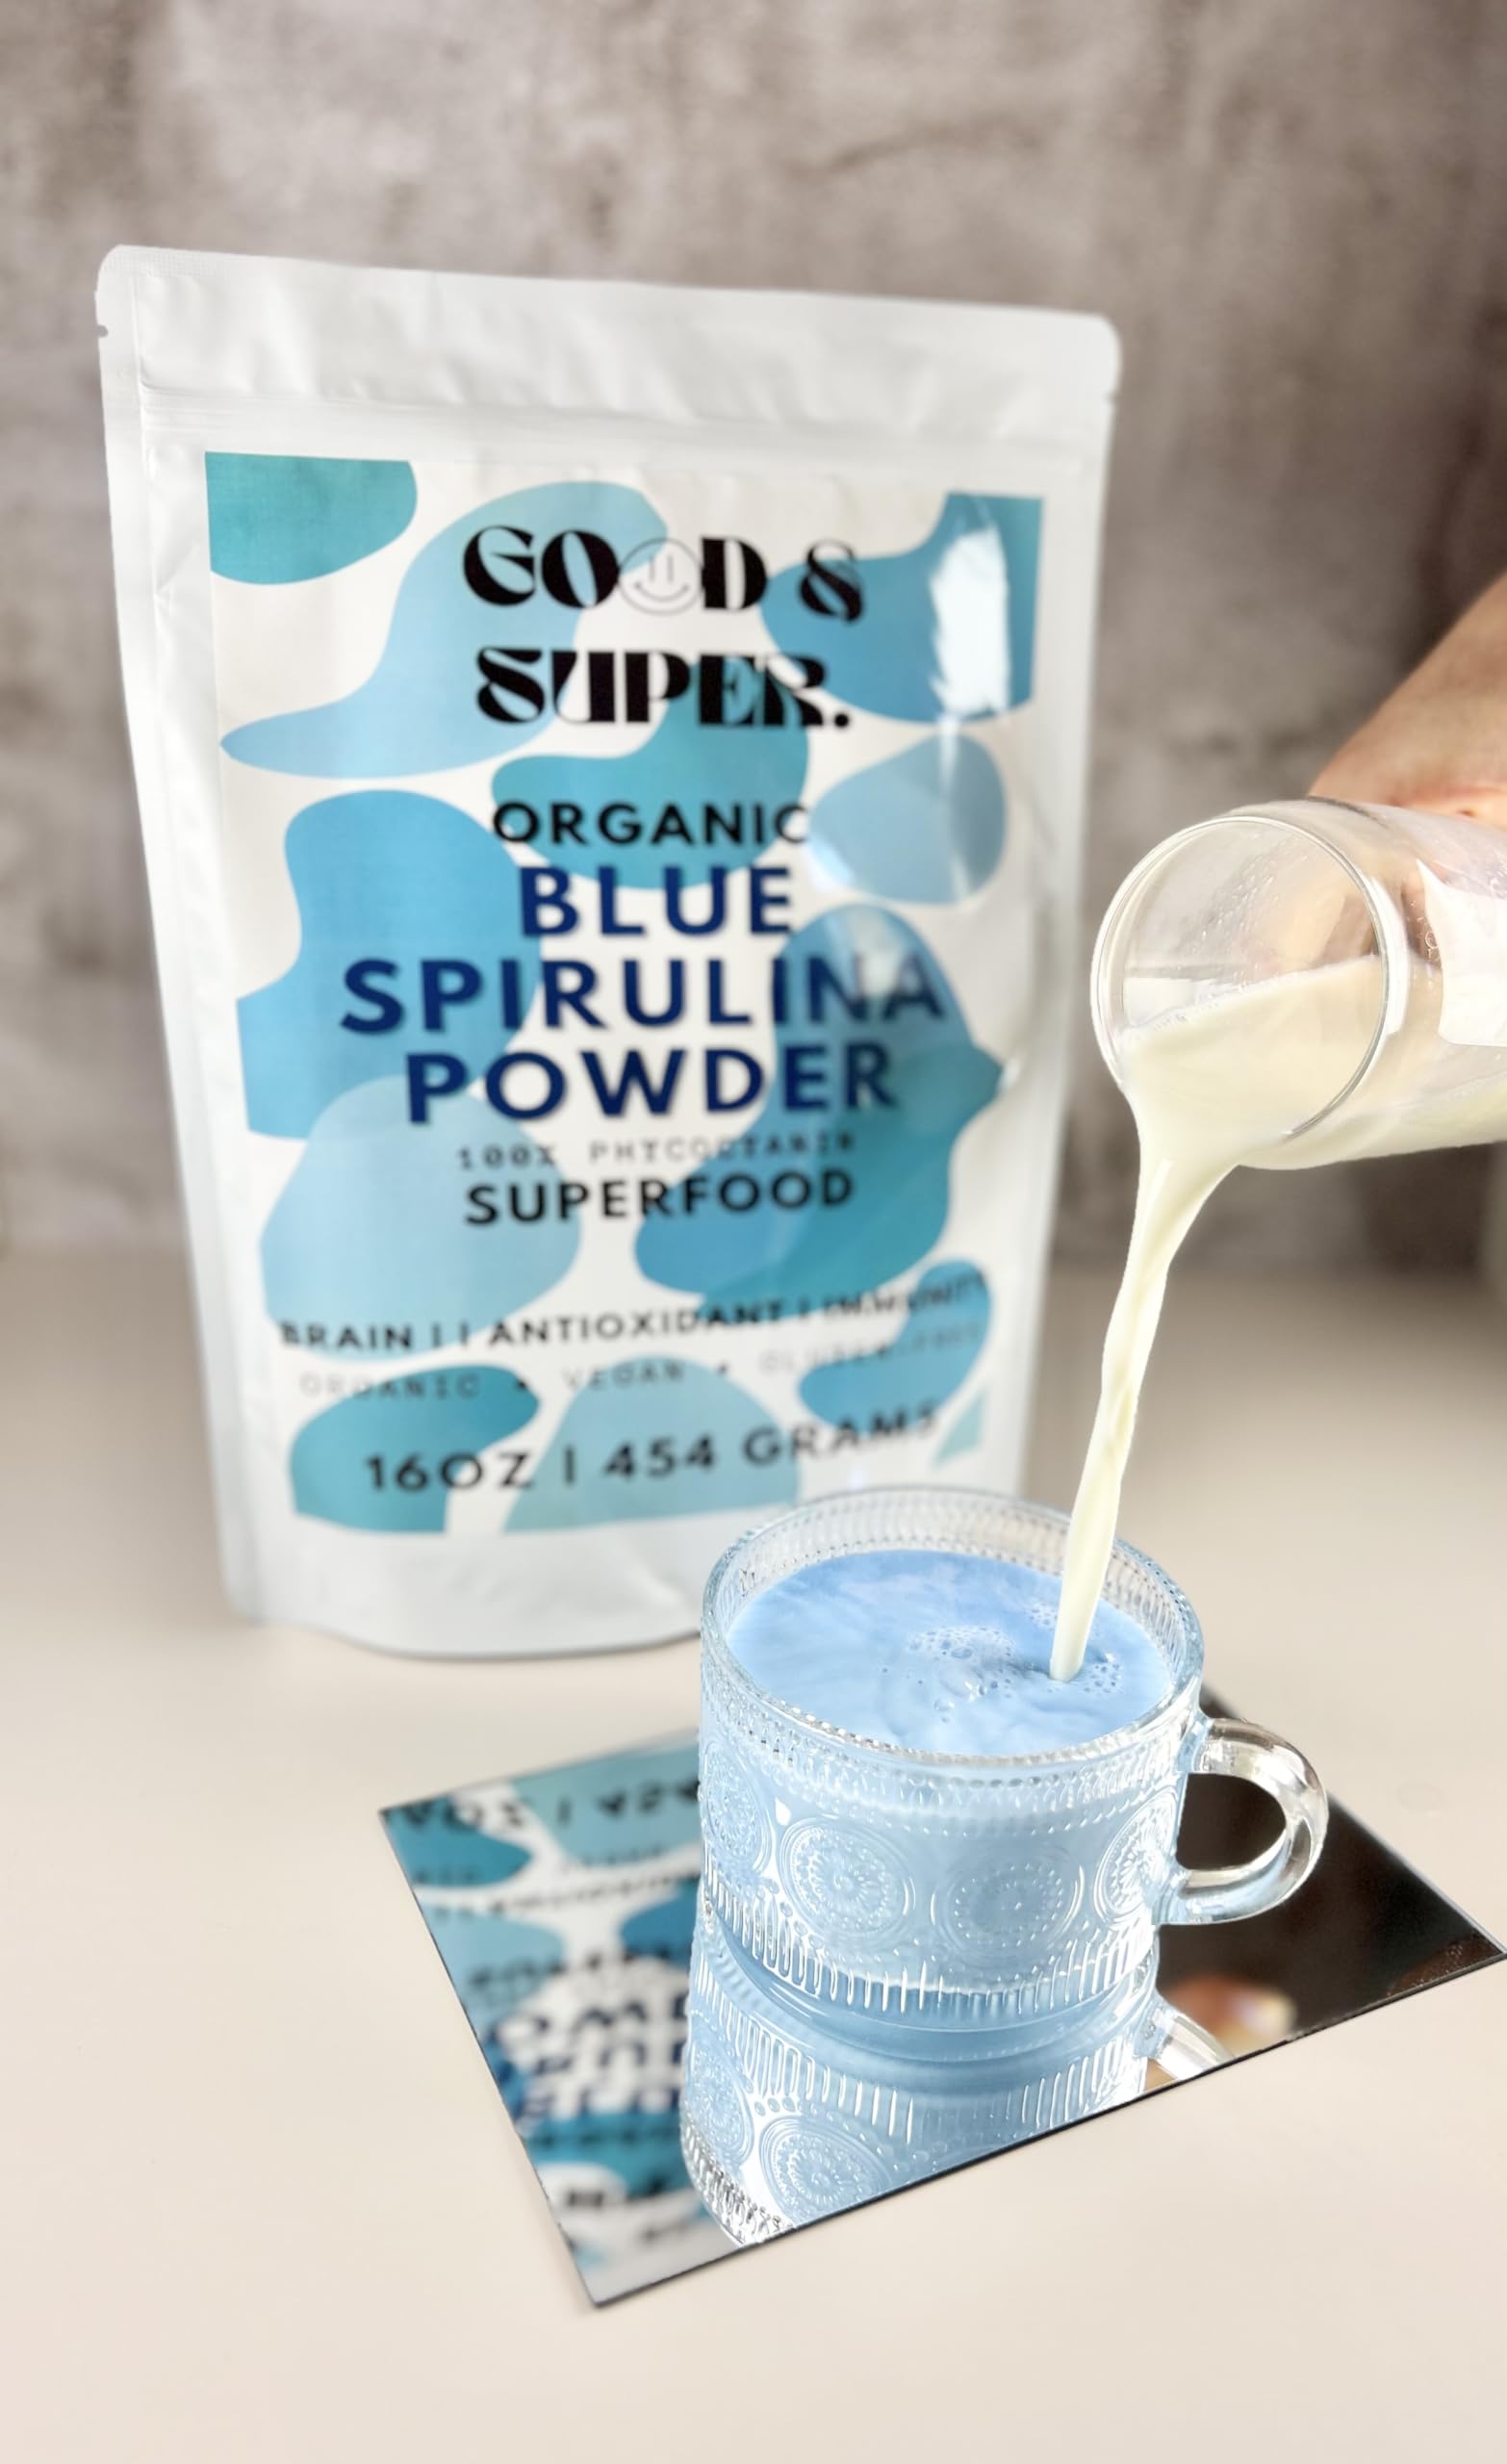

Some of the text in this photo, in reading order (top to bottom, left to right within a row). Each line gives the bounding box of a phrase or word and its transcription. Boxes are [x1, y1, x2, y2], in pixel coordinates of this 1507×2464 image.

[798, 539, 864, 624] &
[475, 646, 851, 730] SUPER.
[492, 799, 810, 846] ORGANIC
[520, 864, 792, 938] BLUE
[339, 955, 946, 1035] SPIRULINA
[405, 1040, 899, 1124] POWDER
[465, 1167, 855, 1227] SUPERFOOD
[280, 1320, 415, 1349] BRAIN
[488, 1297, 783, 1346] ANTIOXIDANT
[603, 1431, 716, 1482] 454
[742, 1398, 938, 1468] GRAMS
